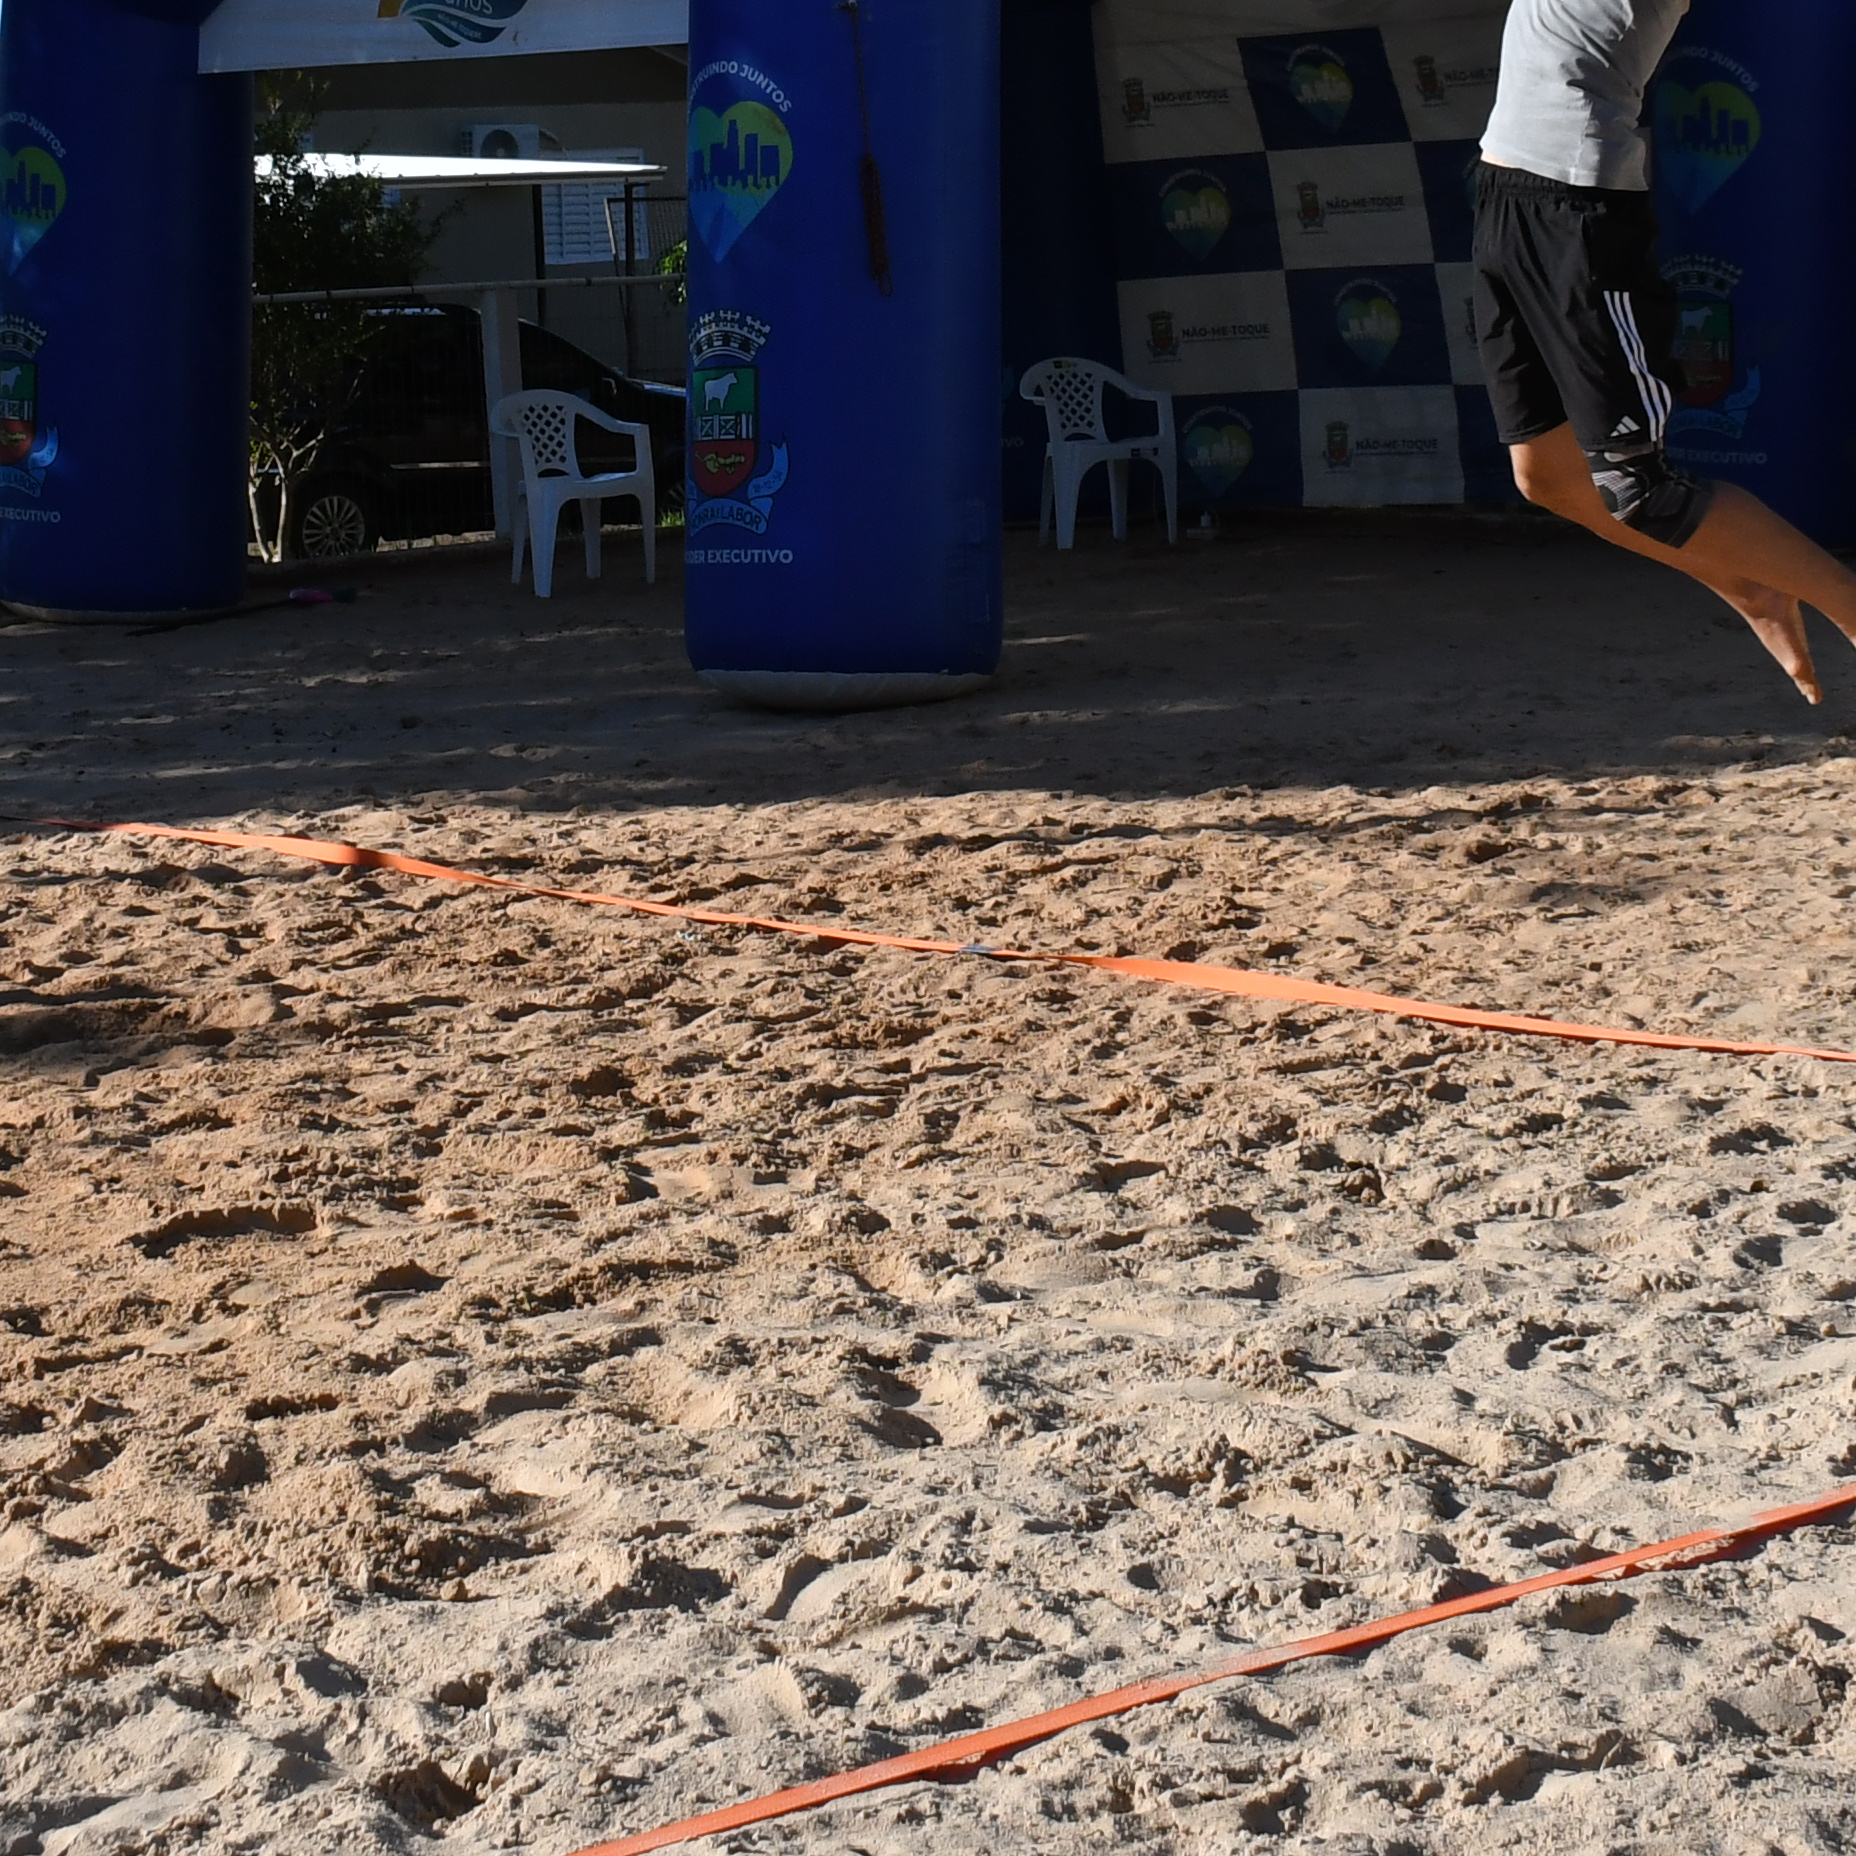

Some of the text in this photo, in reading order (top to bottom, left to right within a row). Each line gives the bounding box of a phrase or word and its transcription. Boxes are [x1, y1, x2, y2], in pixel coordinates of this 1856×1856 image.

[739, 63, 793, 113] JUNTOS
[27, 115, 67, 159] JUNTOS
[1182, 323, 1270, 338] NÃO-ME-TOQUE
[0, 505, 62, 523] EXECUTIVO
[721, 505, 762, 531] LABOR
[707, 548, 794, 564] EXECUTIVO
